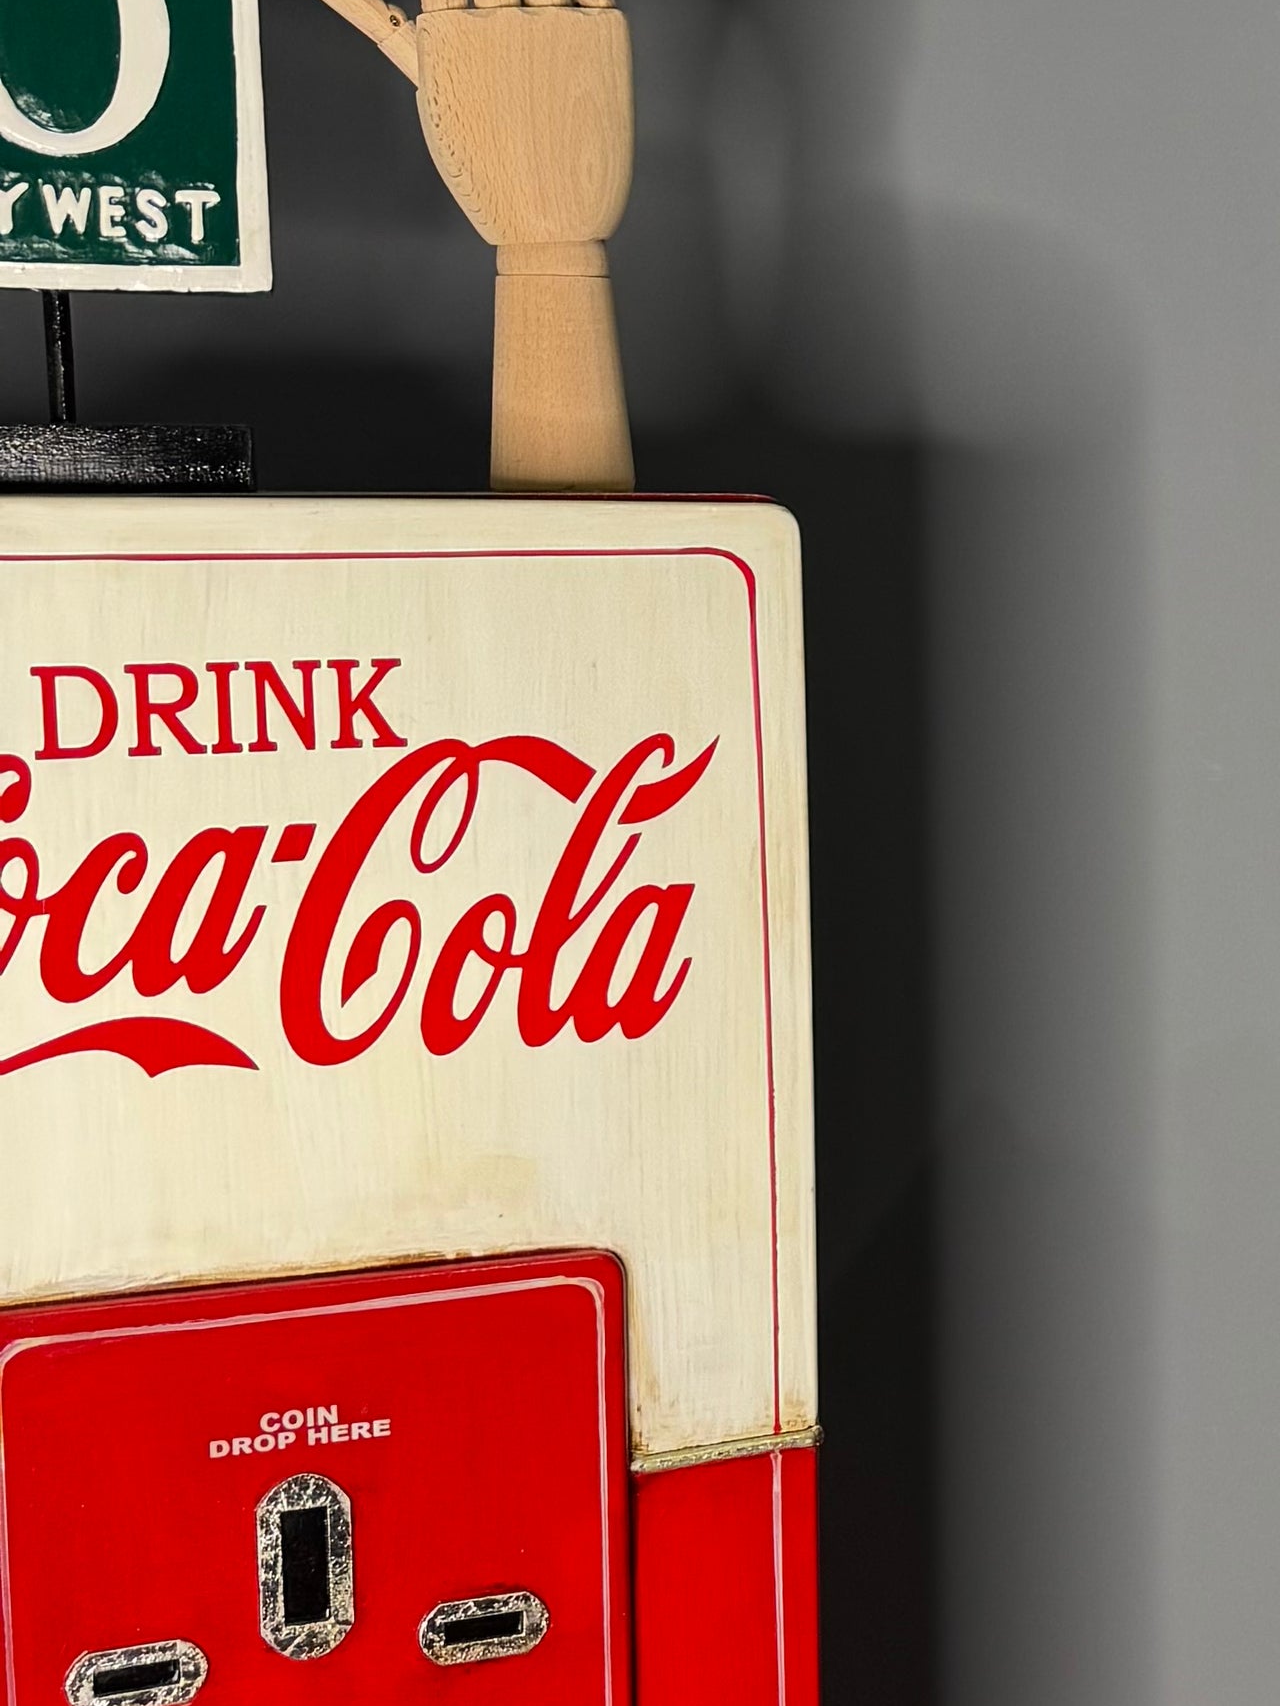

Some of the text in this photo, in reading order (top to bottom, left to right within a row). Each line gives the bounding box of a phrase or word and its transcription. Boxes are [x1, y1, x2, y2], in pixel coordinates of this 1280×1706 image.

[42, 183, 221, 243] WEST
[30, 657, 408, 761] DRINK
[209, 1418, 392, 1459] DROP HERE
[260, 1404, 338, 1433] COIN
